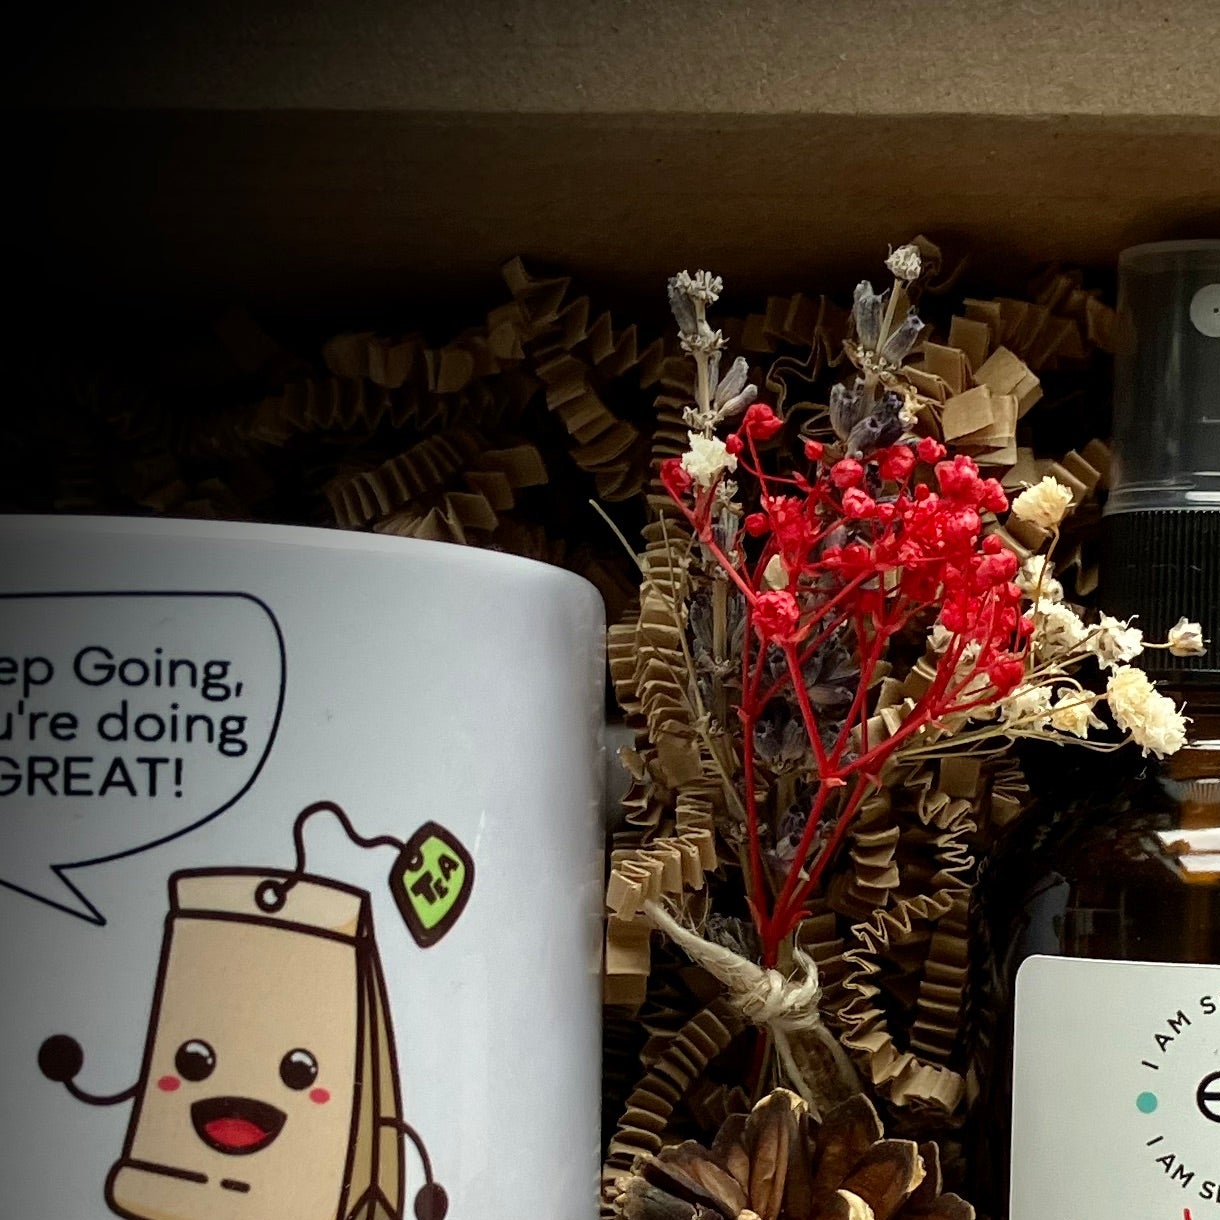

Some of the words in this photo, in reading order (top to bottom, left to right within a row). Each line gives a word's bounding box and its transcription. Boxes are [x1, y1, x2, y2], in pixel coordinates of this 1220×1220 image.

[73, 646, 243, 701] Going,
[97, 700, 248, 757] doing
[1154, 1010, 1192, 1052] AM
[1156, 1153, 1195, 1188] AM
